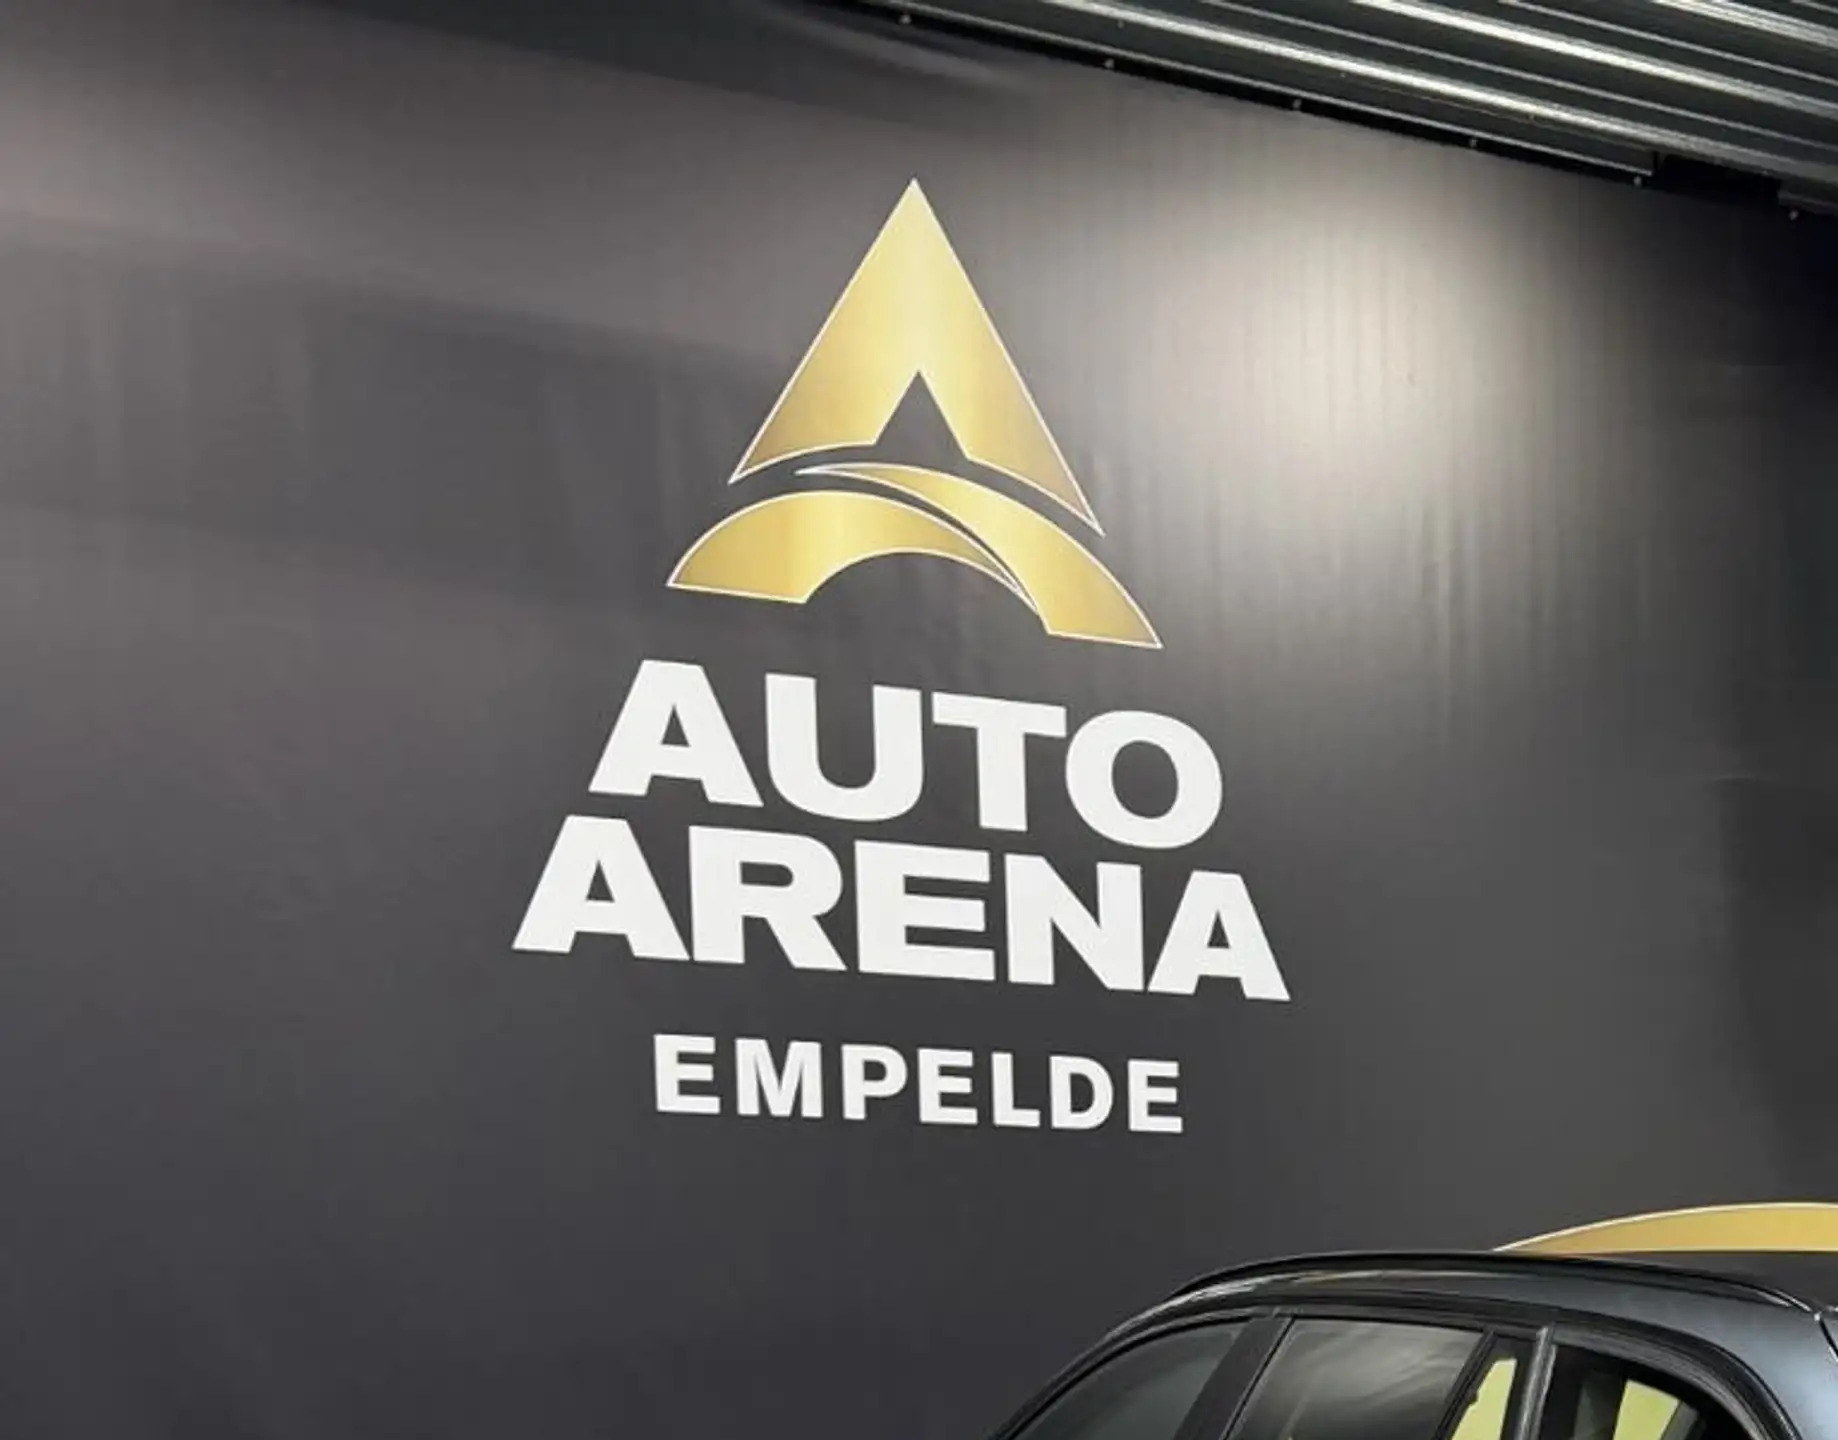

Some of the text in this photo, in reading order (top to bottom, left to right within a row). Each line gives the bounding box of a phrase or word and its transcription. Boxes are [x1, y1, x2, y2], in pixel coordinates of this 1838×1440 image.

[588, 658, 1224, 849] AUTO
[511, 813, 1291, 1001] ARENA
[653, 1033, 1184, 1134] EMPELDE
